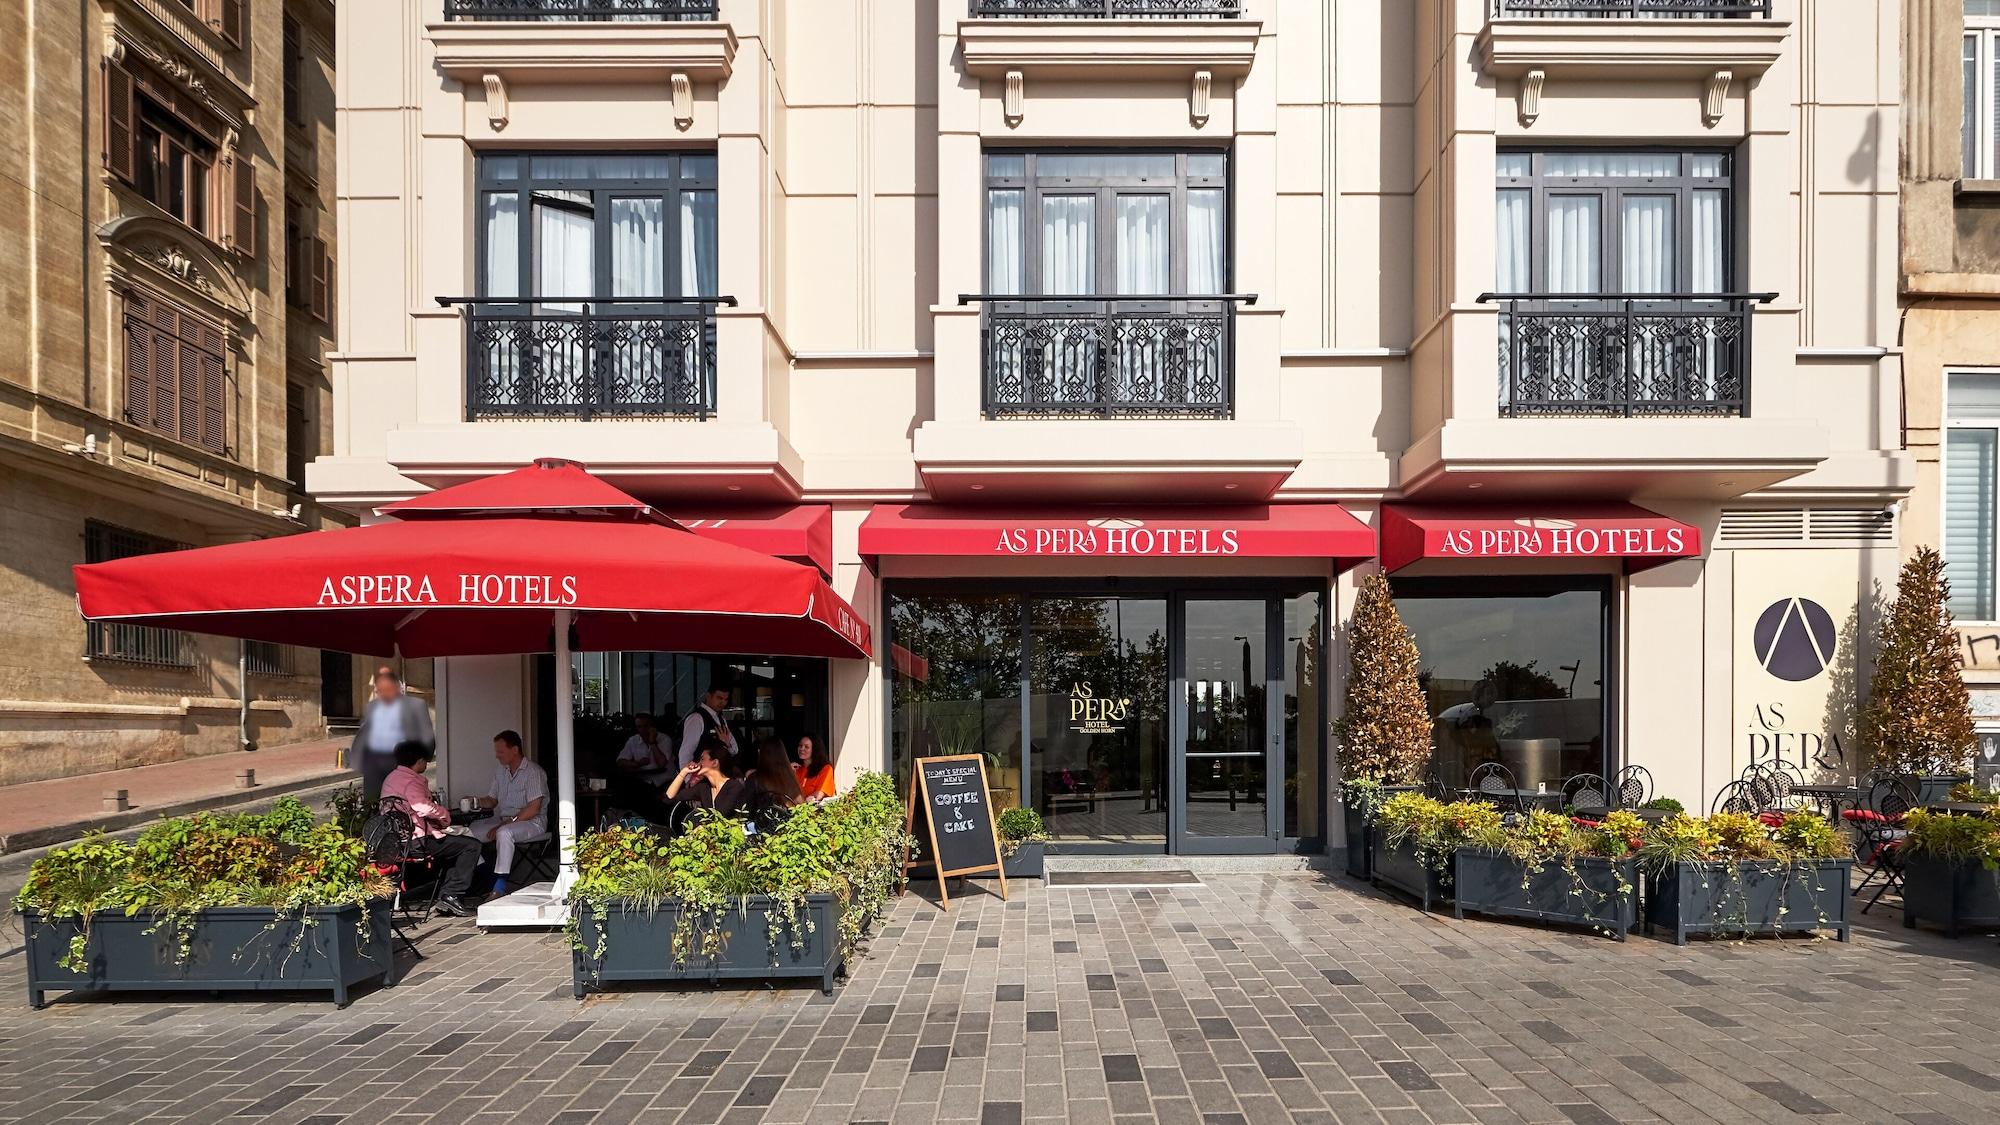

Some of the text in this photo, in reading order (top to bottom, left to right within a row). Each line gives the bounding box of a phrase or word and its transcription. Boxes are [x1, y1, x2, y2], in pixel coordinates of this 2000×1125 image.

[995, 528, 1240, 554] AS PERA HOTELS
[1441, 528, 1684, 555] AS PERA HOTELS
[316, 574, 578, 605] ASPERA HOTELS
[1070, 681, 1092, 699] AS
[1070, 698, 1127, 720] PERA
[1748, 702, 1785, 732] AS
[1748, 733, 1844, 770] PERA
[925, 766, 977, 777] TODAY'S SPECIAL
[935, 791, 979, 806] COFFEE
[943, 818, 975, 833] CAKE
